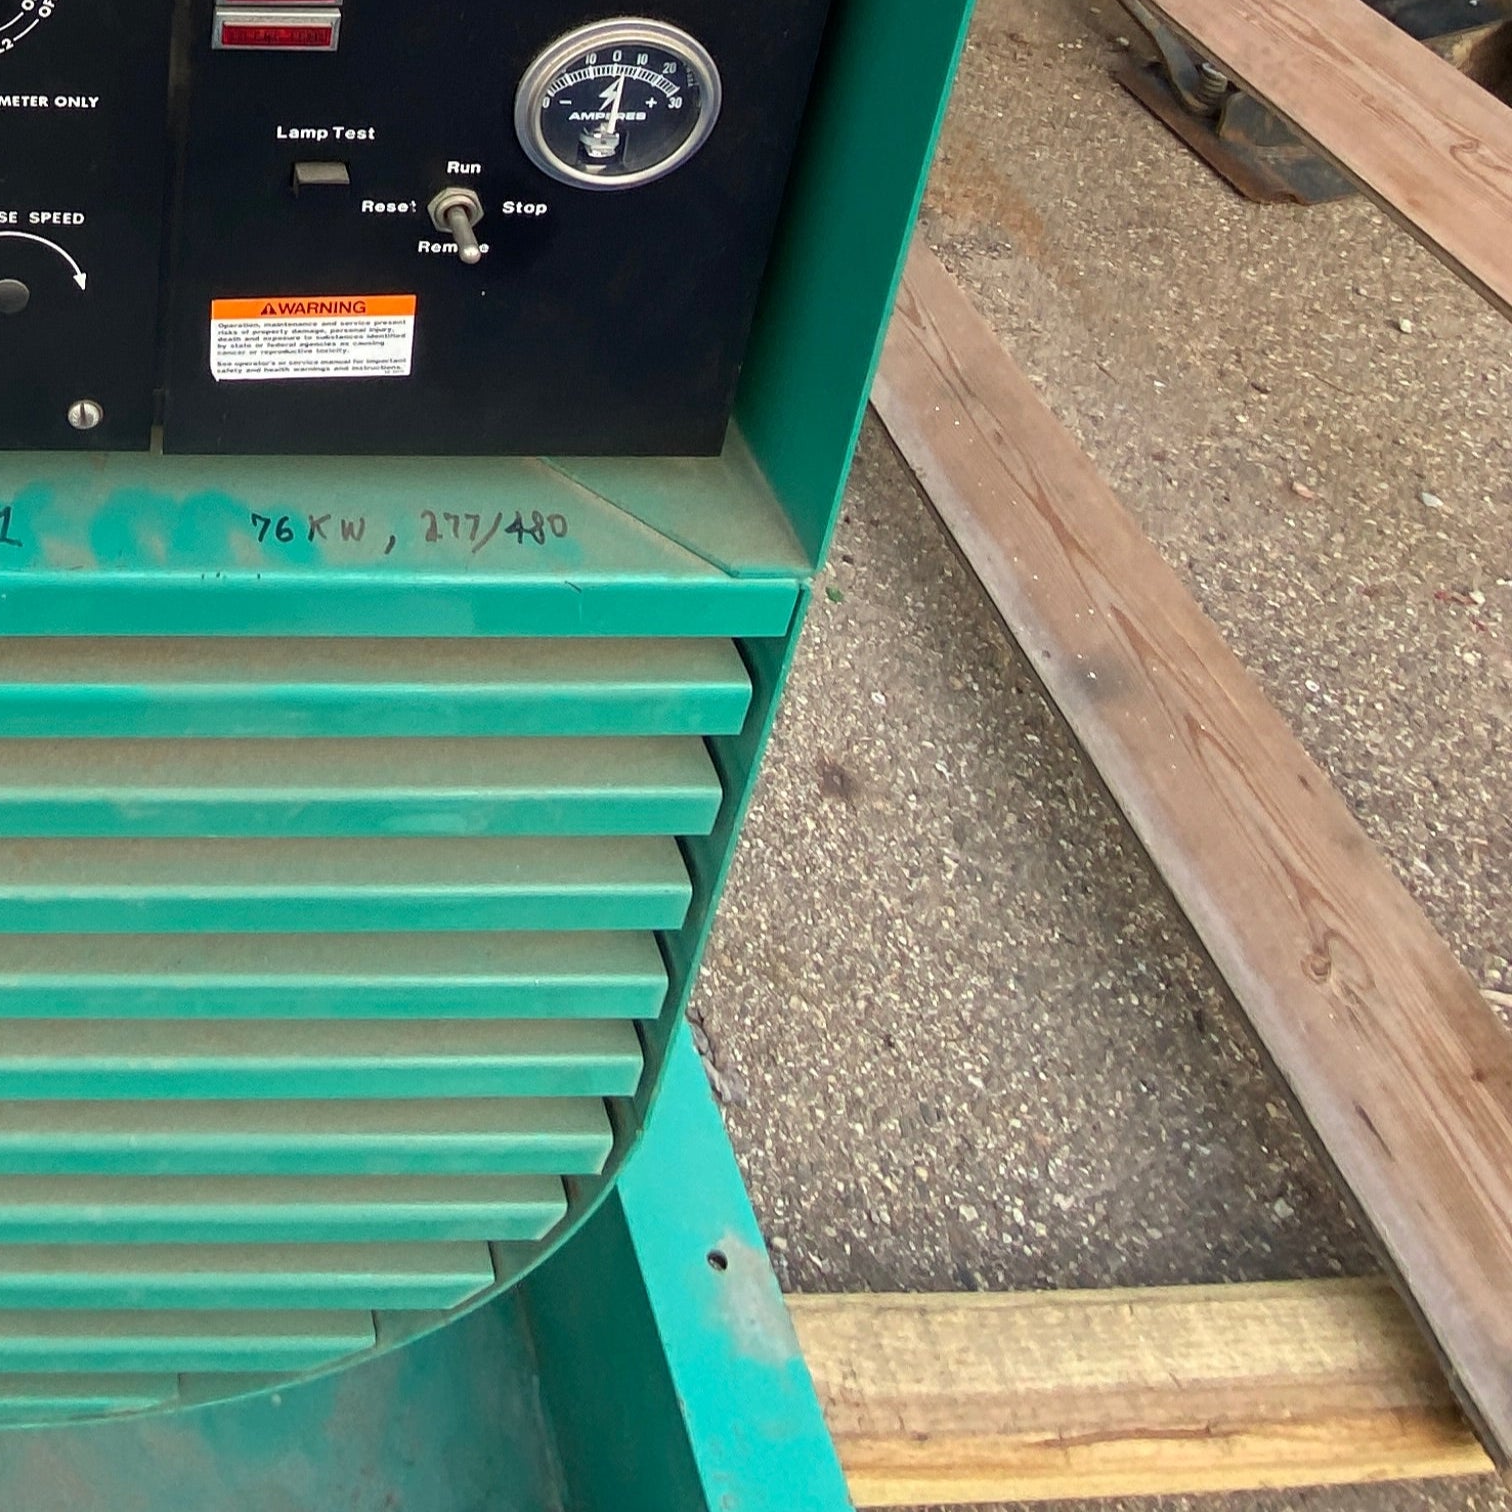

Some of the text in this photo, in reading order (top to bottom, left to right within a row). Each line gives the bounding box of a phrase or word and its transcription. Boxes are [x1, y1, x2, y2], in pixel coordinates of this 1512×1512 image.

[585, 53, 597, 65] 10
[612, 50, 622, 62] 0
[637, 53, 649, 65] 10
[662, 62, 677, 74] 20
[54, 96, 100, 108] ONLY
[668, 96, 683, 109] 30
[276, 126, 376, 141] Lamp Test
[446, 161, 481, 174] Run
[361, 200, 417, 213] Reset
[502, 201, 548, 216] Stop
[29, 212, 85, 225] SPEED
[418, 240, 489, 253] Reme
[278, 301, 366, 315] WARNING
[251, 513, 294, 543] 76
[421, 509, 568, 554] 277/480
